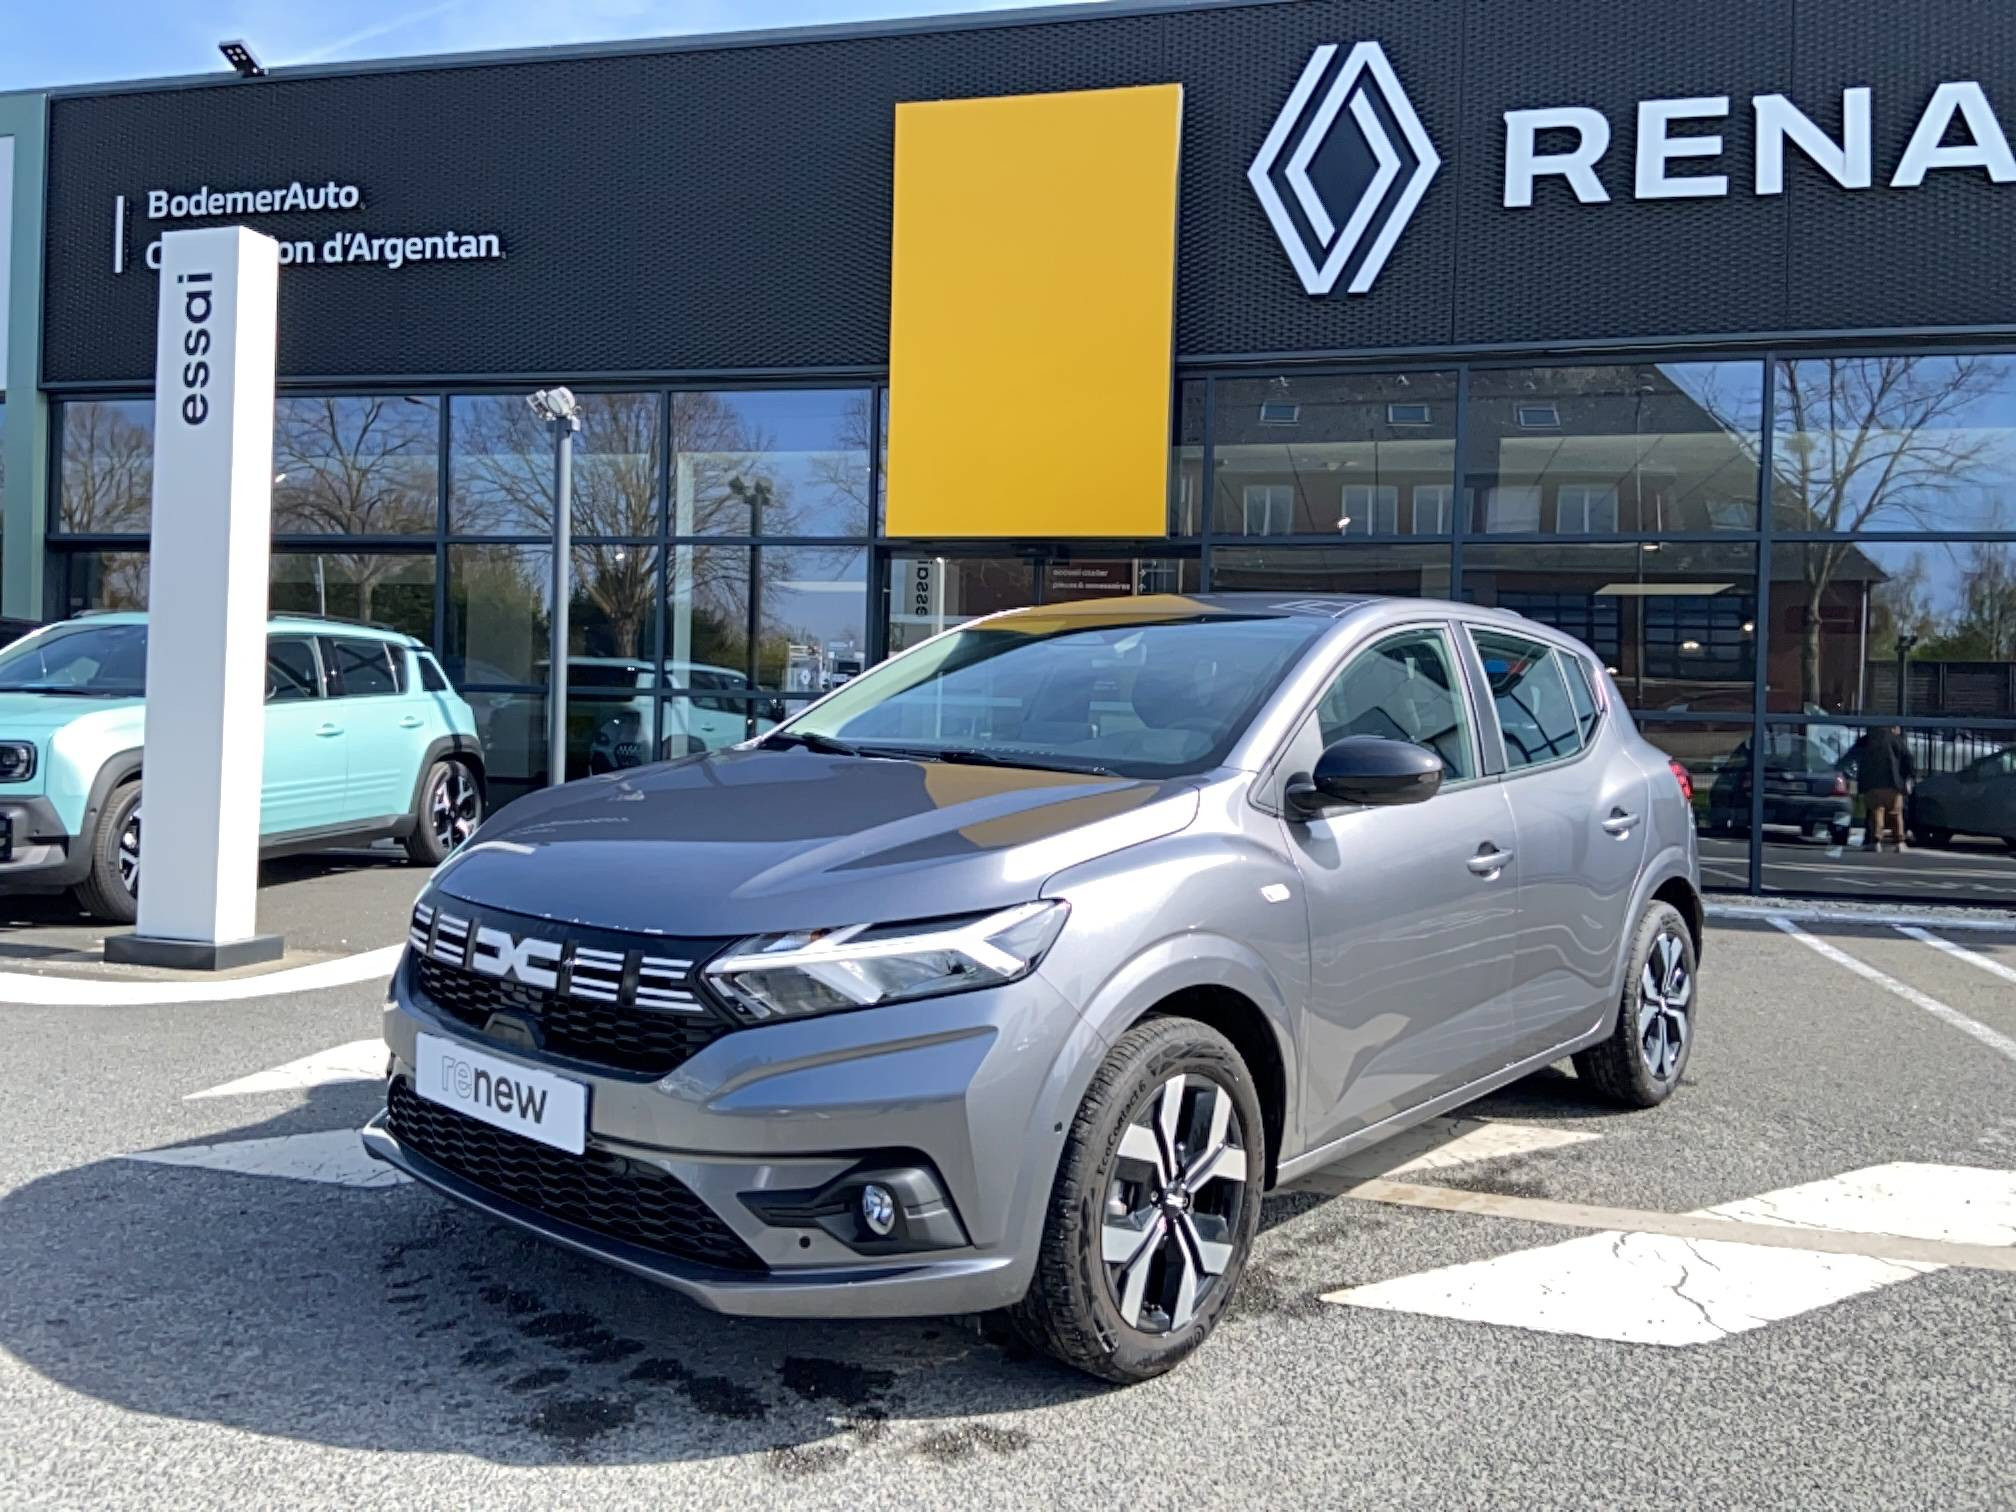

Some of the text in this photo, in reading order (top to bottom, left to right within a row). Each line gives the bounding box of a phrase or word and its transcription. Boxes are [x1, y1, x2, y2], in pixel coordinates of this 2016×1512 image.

[1503, 81, 2016, 207] RENA
[148, 182, 360, 218] BodemerAuto
[323, 231, 501, 269] d'Argentan
[177, 273, 213, 425] essai
[441, 1055, 547, 1124] renew
